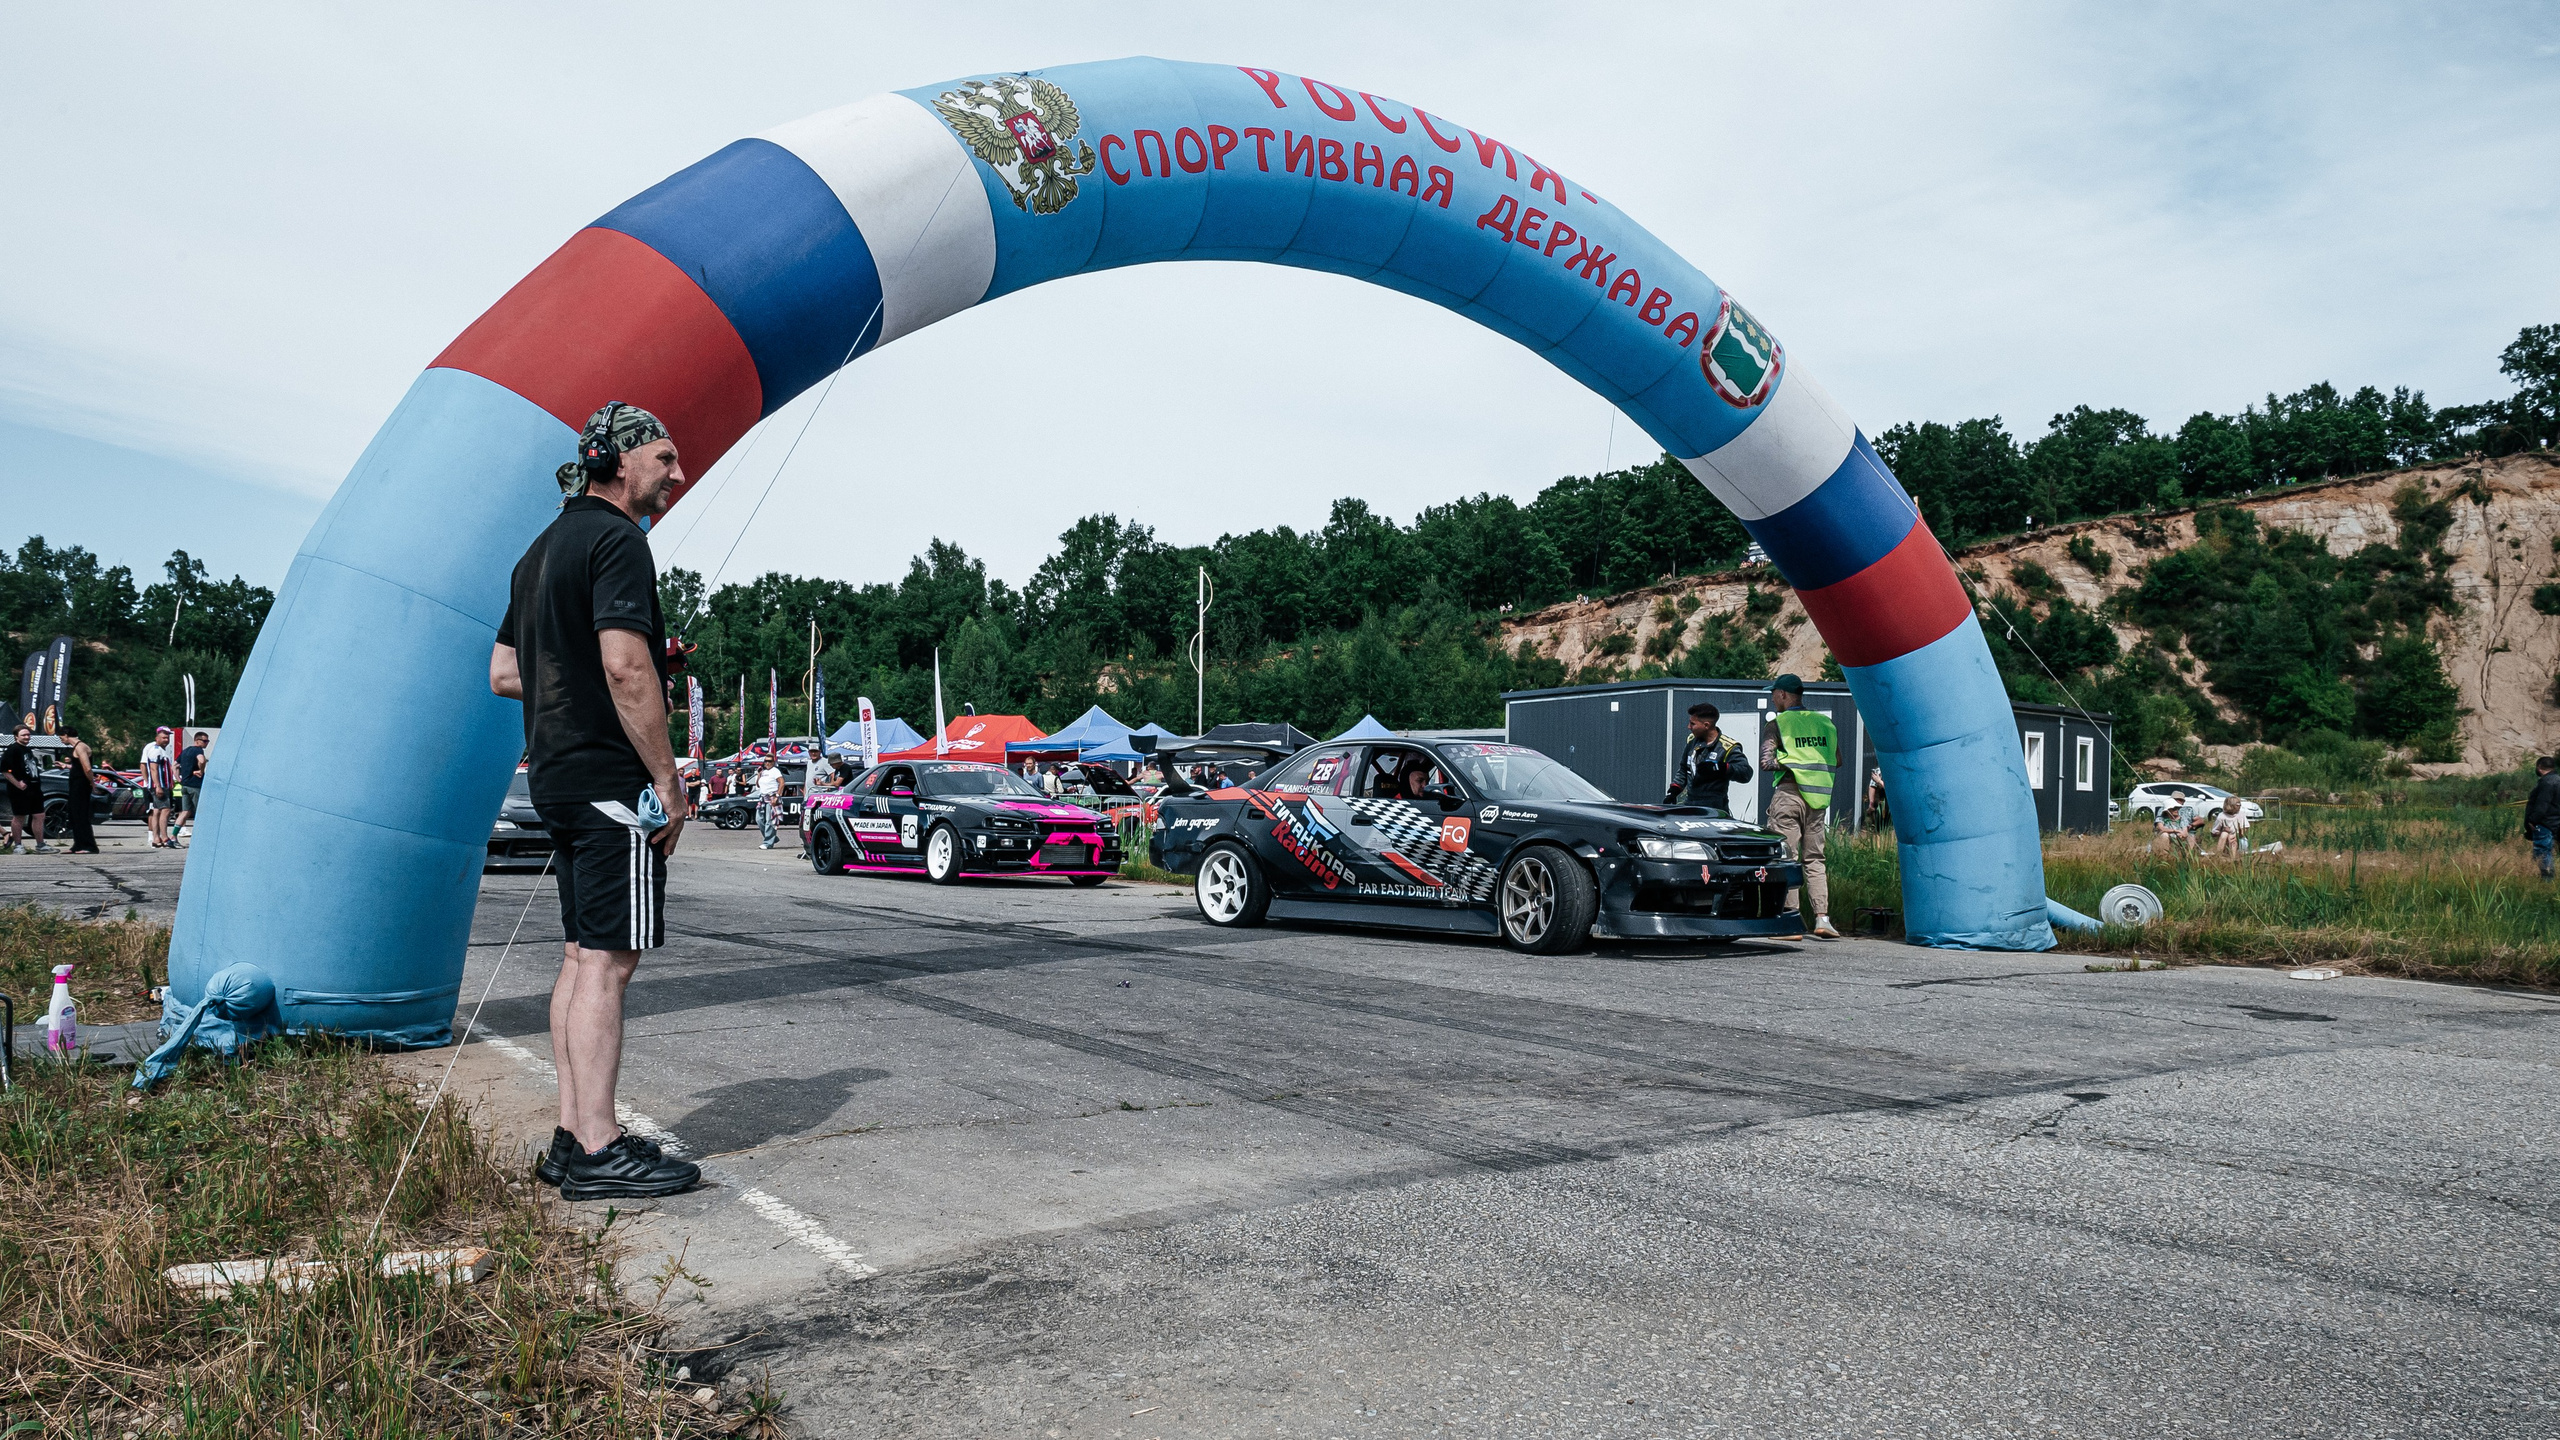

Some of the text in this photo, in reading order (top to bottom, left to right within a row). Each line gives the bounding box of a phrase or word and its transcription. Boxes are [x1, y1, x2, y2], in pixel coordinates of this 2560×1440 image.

[1100, 124, 1699, 348] СПОРТИВНАЯ ДЕРЖАВА
[1795, 736, 1827, 748] ПРЕССА
[1312, 763, 1334, 781] 28
[1283, 784, 1325, 793] KANISHCHEV
[903, 823, 917, 839] FQ
[1171, 818, 1220, 830] jdm garage
[1271, 798, 1356, 885] ТИТАНКЛАВ
[1441, 825, 1467, 844] FQ
[1271, 819, 1340, 890] Racing
[1358, 882, 1469, 901] FAR EAST DRIFT TEAM
